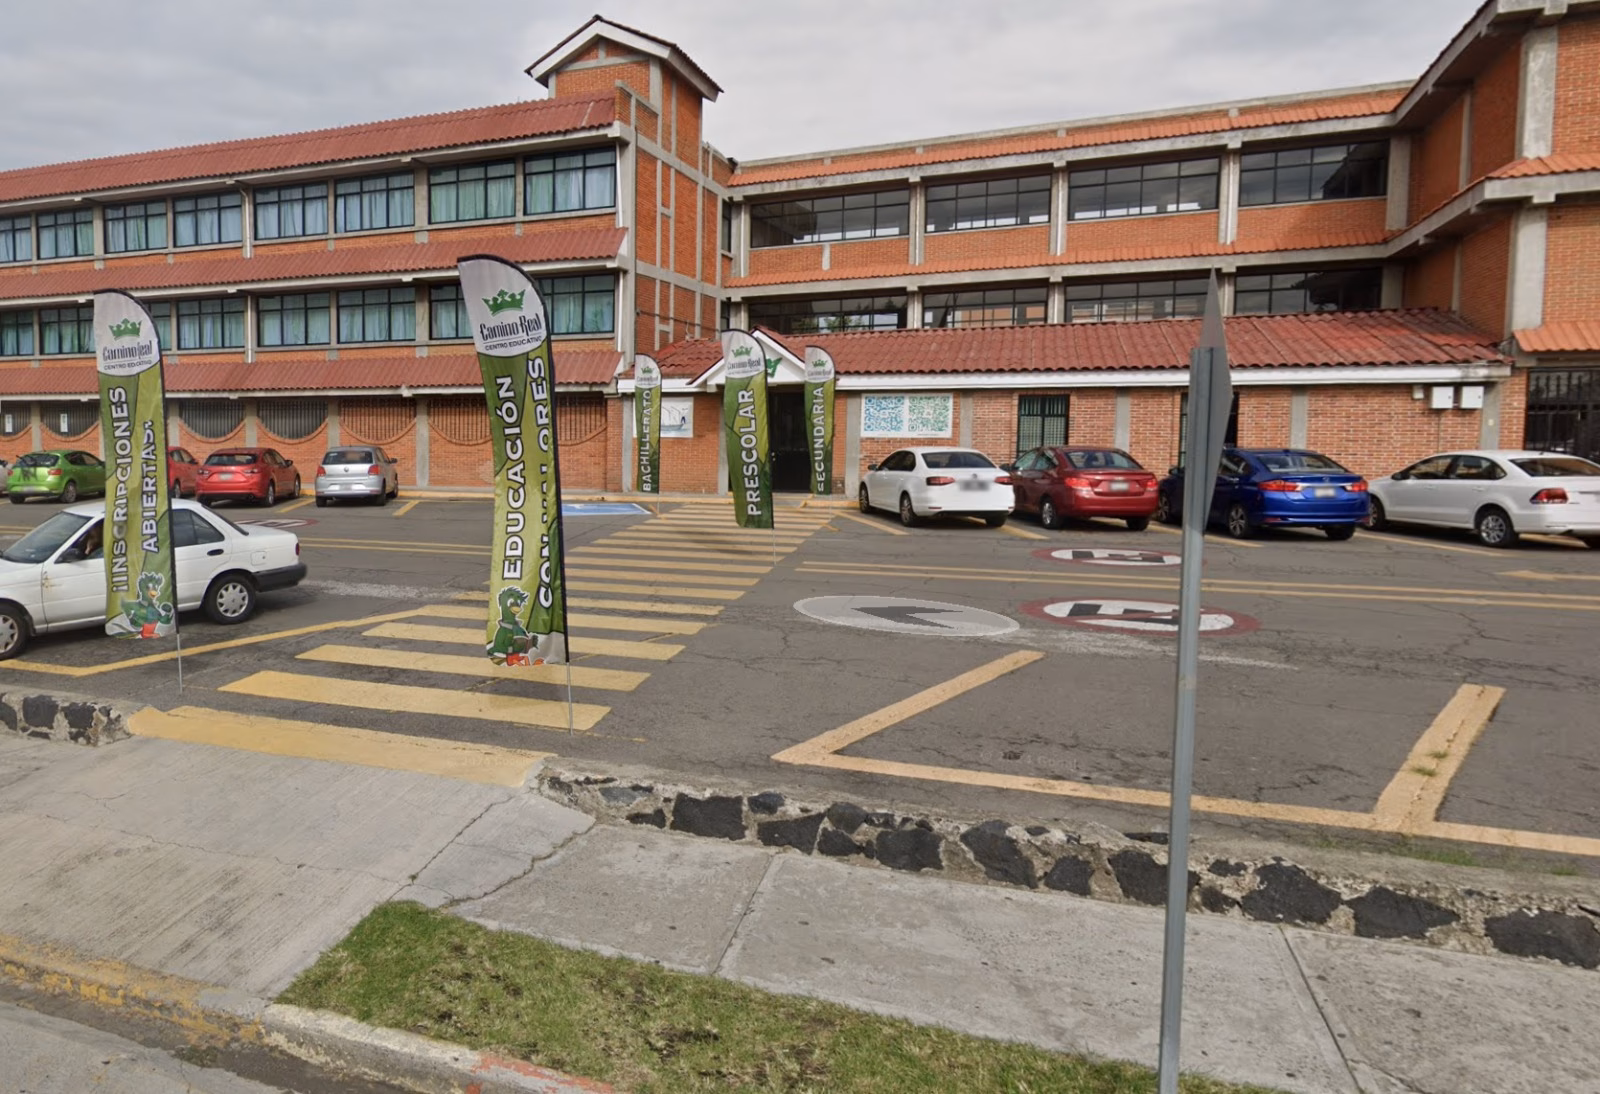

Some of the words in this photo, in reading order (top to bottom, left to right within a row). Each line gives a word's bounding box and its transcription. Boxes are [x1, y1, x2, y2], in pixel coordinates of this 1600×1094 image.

[102, 344, 137, 361] Camino
[480, 322, 519, 341] Camino
[519, 312, 542, 337] Real
[485, 342, 508, 351] CENTRO
[496, 376, 526, 580] EDUCACIÓN
[641, 390, 652, 492] BACHILLERATO
[738, 387, 762, 516] PRESCOLAR
[812, 386, 826, 492] SECUNDARIA
